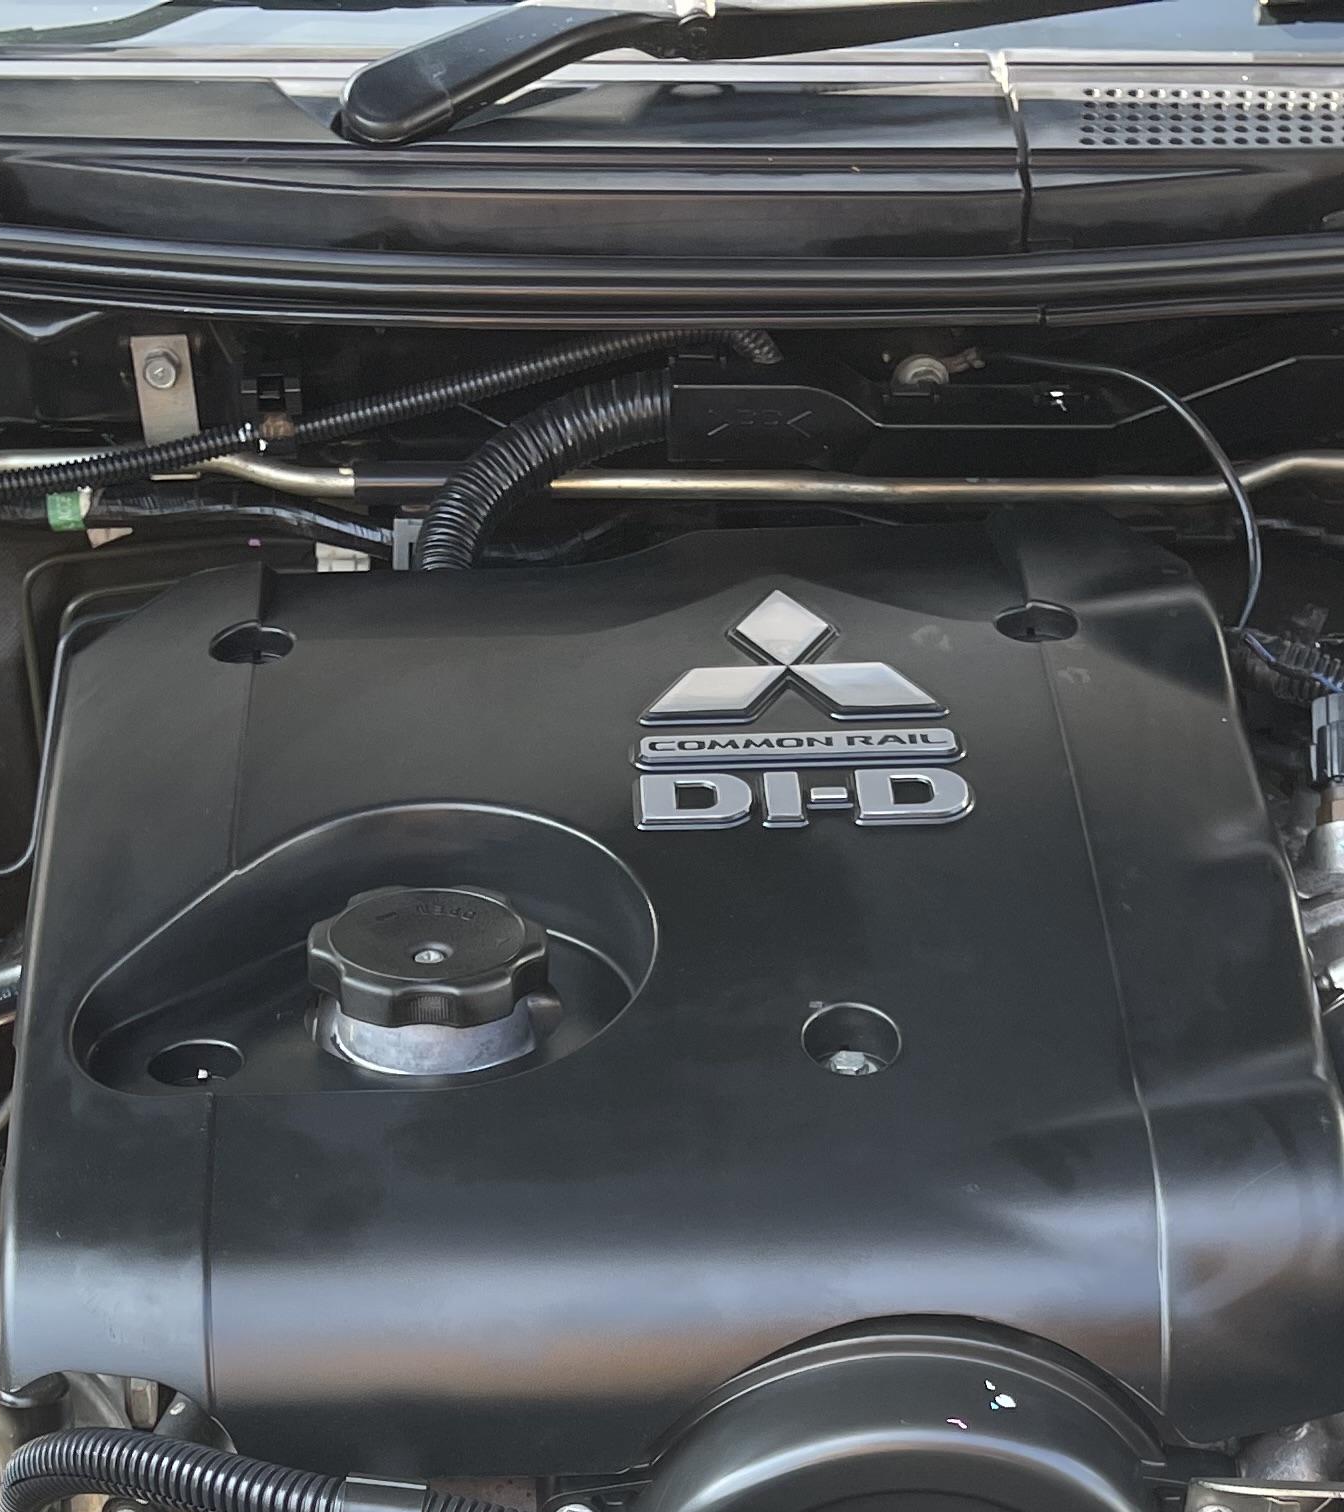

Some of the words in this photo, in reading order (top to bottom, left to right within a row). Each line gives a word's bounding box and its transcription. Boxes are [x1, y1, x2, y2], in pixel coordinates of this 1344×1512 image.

[648, 736, 834, 752] COMMON
[846, 733, 949, 749] RAIL
[637, 768, 975, 831] DI-D
